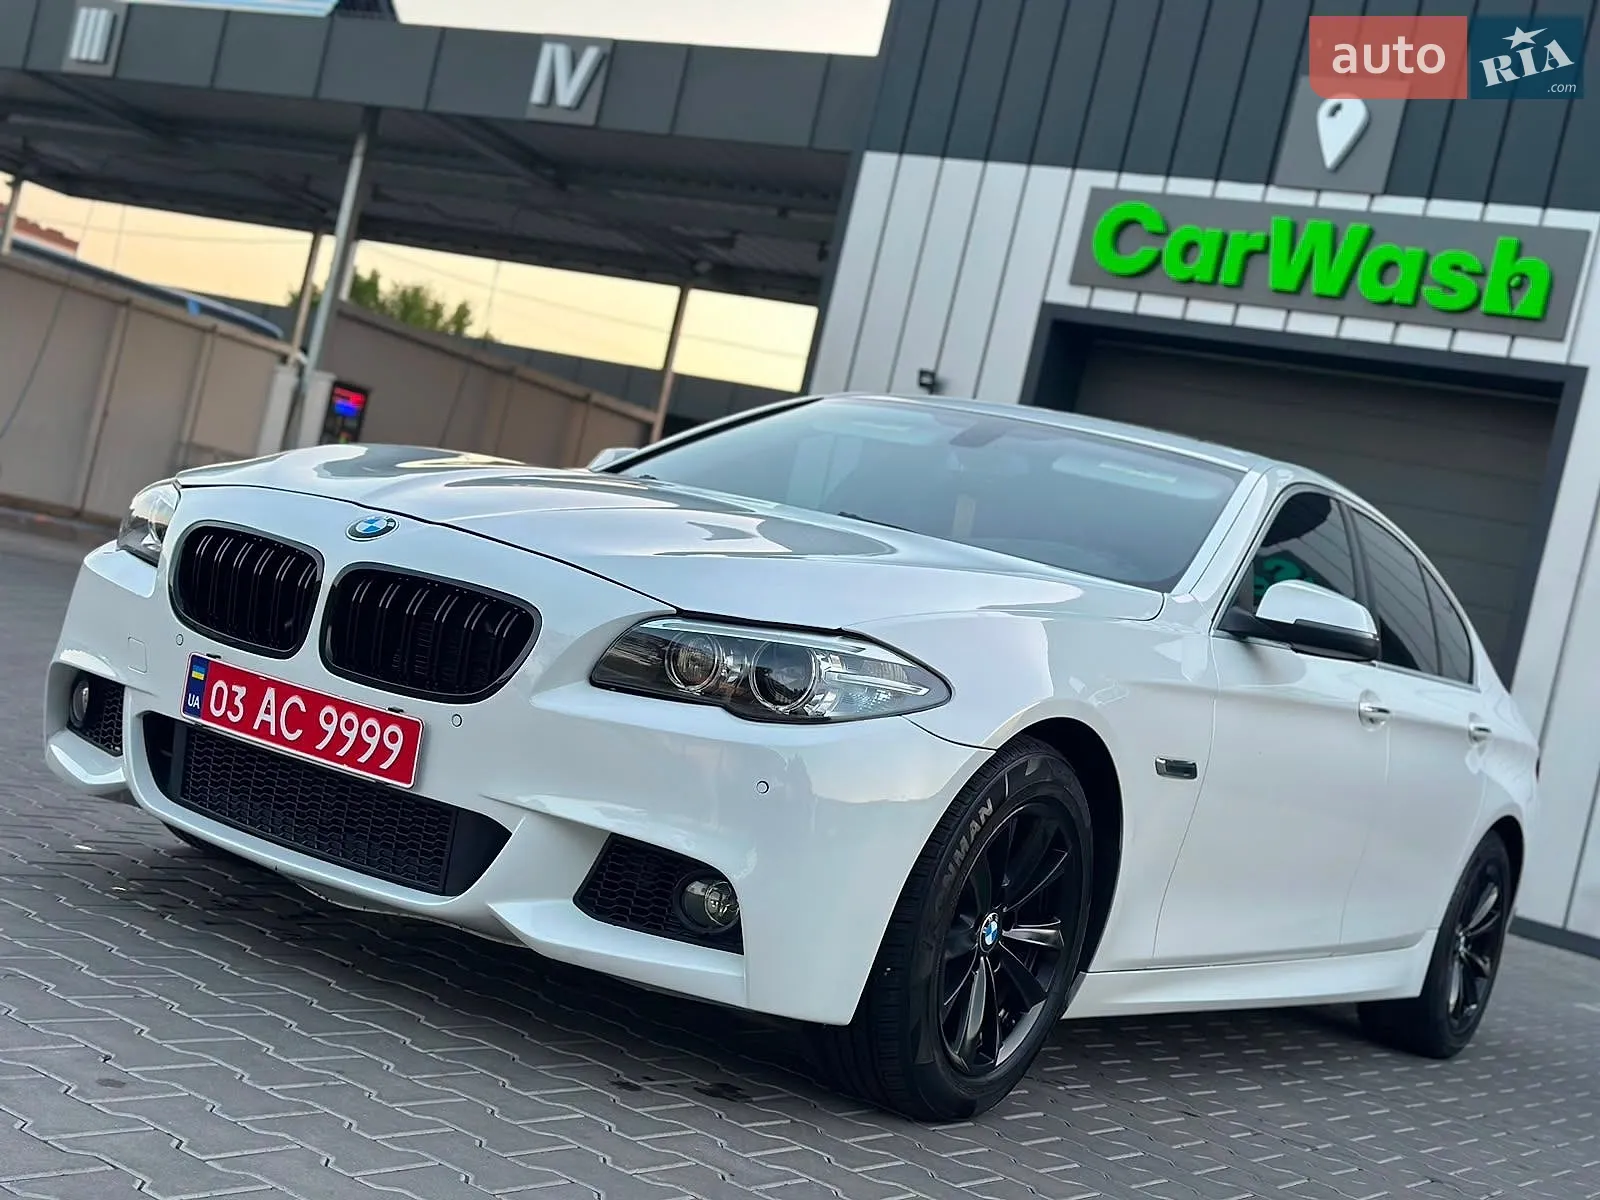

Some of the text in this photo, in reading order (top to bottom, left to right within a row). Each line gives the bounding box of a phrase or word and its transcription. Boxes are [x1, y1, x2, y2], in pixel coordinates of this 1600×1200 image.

[69, 7, 112, 62] III
[529, 42, 601, 107] IV
[1092, 200, 1552, 320] CarWash
[187, 693, 201, 709] UA
[209, 679, 404, 770] 03 AC 9999
